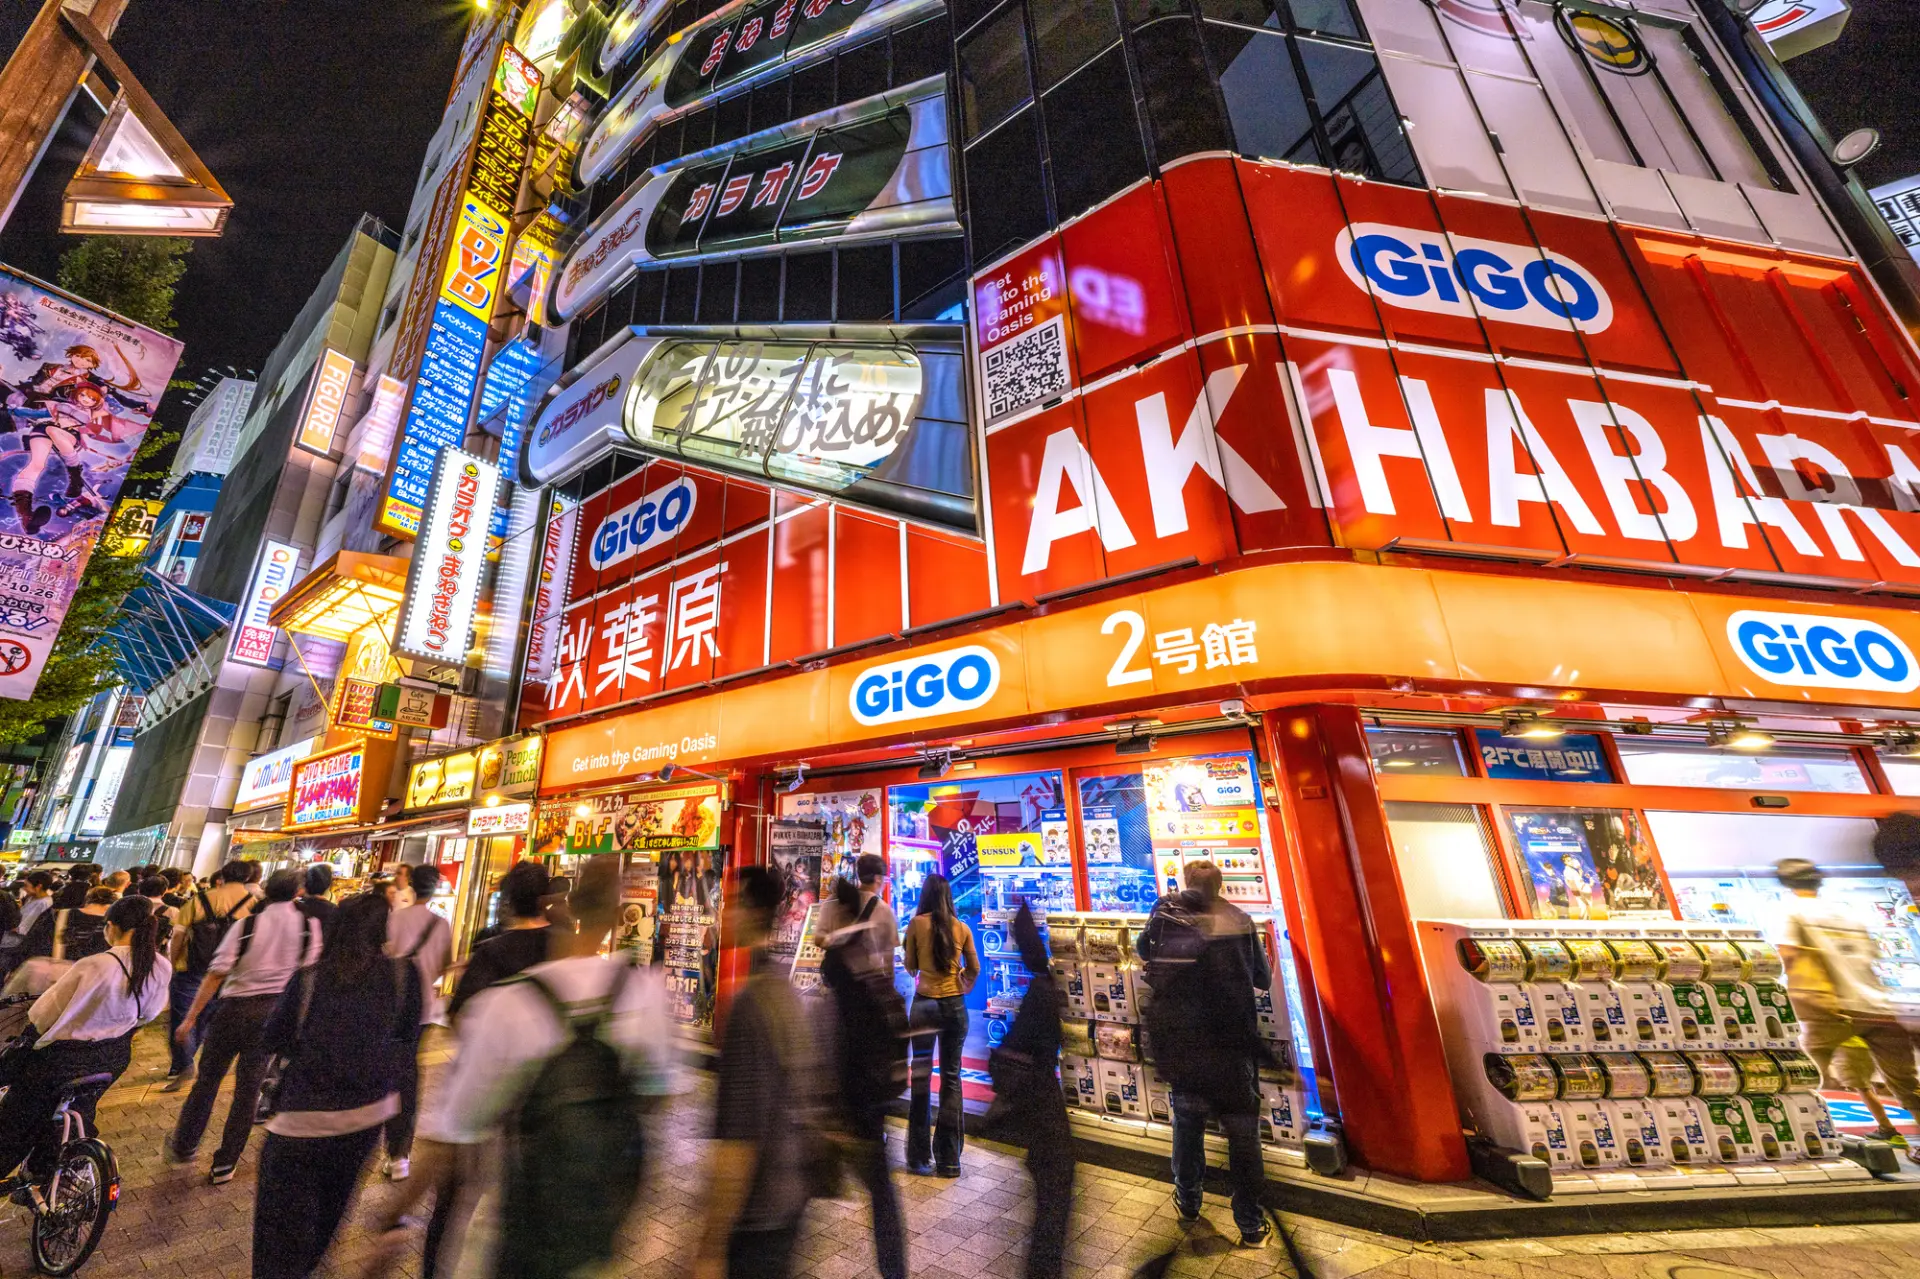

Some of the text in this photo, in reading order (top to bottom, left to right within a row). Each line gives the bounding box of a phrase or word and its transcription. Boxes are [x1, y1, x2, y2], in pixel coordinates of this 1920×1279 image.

[494, 96, 528, 131] ゲーム
[494, 113, 523, 140] CD
[480, 135, 522, 172] アニメ
[486, 121, 525, 157] アイドル
[476, 168, 511, 198] ホビー
[478, 151, 516, 184] コミック
[470, 180, 509, 213] フィギュア
[680, 152, 843, 226] カラオケ
[447, 226, 500, 309] DVD
[564, 207, 643, 298] まねきねこ
[983, 271, 1012, 296] Get
[1021, 270, 1049, 291] the
[1350, 233, 1600, 322] GiGO
[986, 287, 1052, 327] Gaming
[432, 322, 446, 334] 5F
[440, 311, 482, 340] イベントスペース
[987, 312, 1034, 343] Oasis
[424, 350, 439, 361] 4F
[418, 377, 432, 388] 3F
[642, 343, 764, 402] ゲームの
[307, 364, 347, 438] FIGURE
[548, 379, 611, 443] カラオケ
[675, 350, 854, 439] オアシスに
[205, 385, 237, 456] AKIHABARA
[222, 384, 257, 457] WELCOME TO
[411, 406, 461, 435] 2F アイドルグッズ
[735, 393, 920, 457] 飛び込め!
[404, 436, 437, 457] 1F GAME
[395, 466, 410, 478] B1
[388, 511, 411, 523] MEDIA
[593, 484, 691, 563] GiGO
[424, 474, 479, 651] カラオケ まねきねこ
[242, 638, 268, 652] TAX
[243, 628, 271, 643] 免税
[544, 562, 728, 710] 秋葉原
[1100, 610, 1258, 688] 2号館
[1738, 620, 1909, 682] GiGO
[237, 647, 267, 660] FREE
[856, 654, 992, 714] GiGO
[505, 749, 538, 766] Pepper
[572, 734, 717, 773] Get into the Gaming Oasis
[1482, 746, 1600, 770] 2Fで展開中!!
[502, 764, 536, 787] Lunch
[1217, 786, 1241, 794] GiGO
[574, 821, 592, 848] B1
